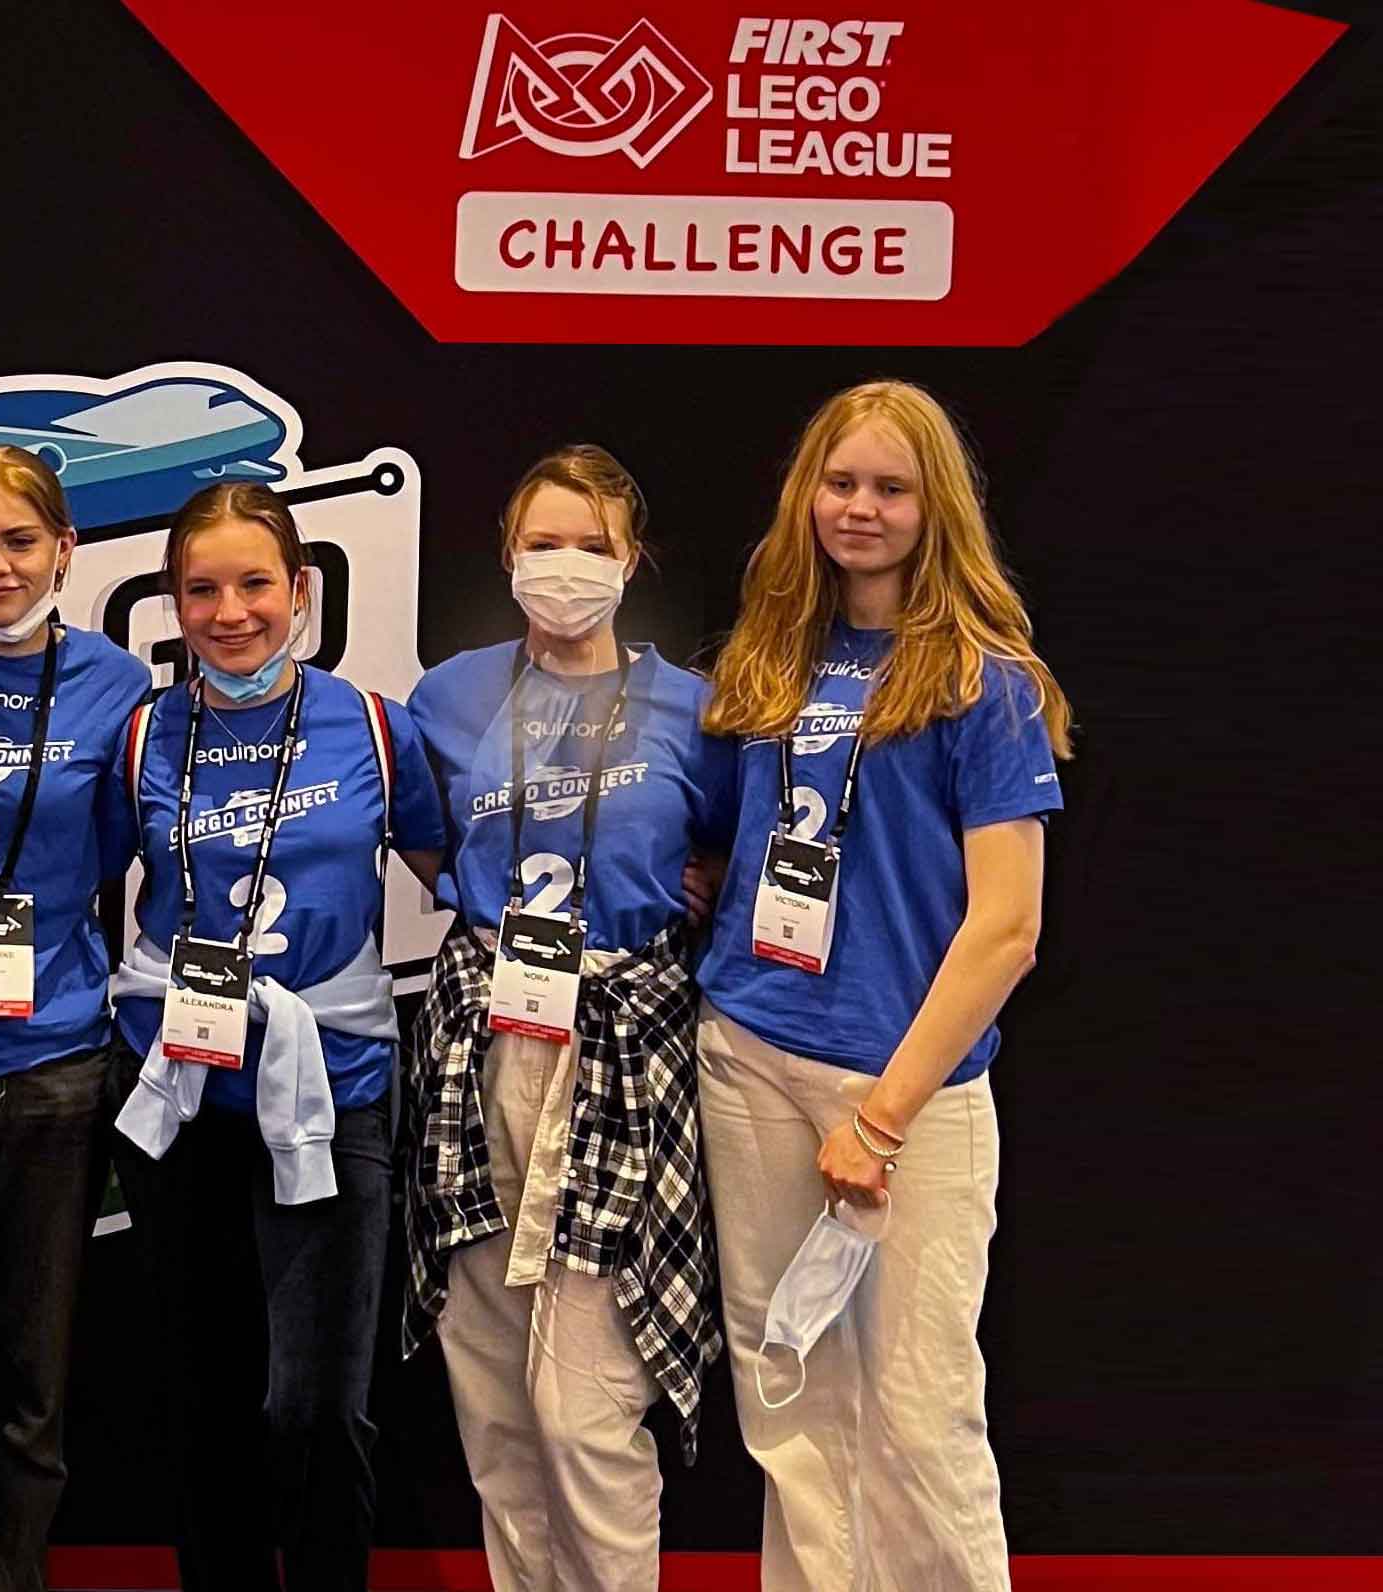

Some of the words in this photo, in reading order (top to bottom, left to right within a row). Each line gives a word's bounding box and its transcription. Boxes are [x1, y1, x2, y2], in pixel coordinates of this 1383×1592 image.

[729, 17, 905, 67] FIRST
[727, 74, 881, 122] LEGO
[726, 128, 952, 178] LEAGUE
[499, 219, 908, 276] CHALLENGE
[195, 742, 283, 768] equinor
[472, 783, 538, 812] CARO
[229, 873, 289, 955] 2
